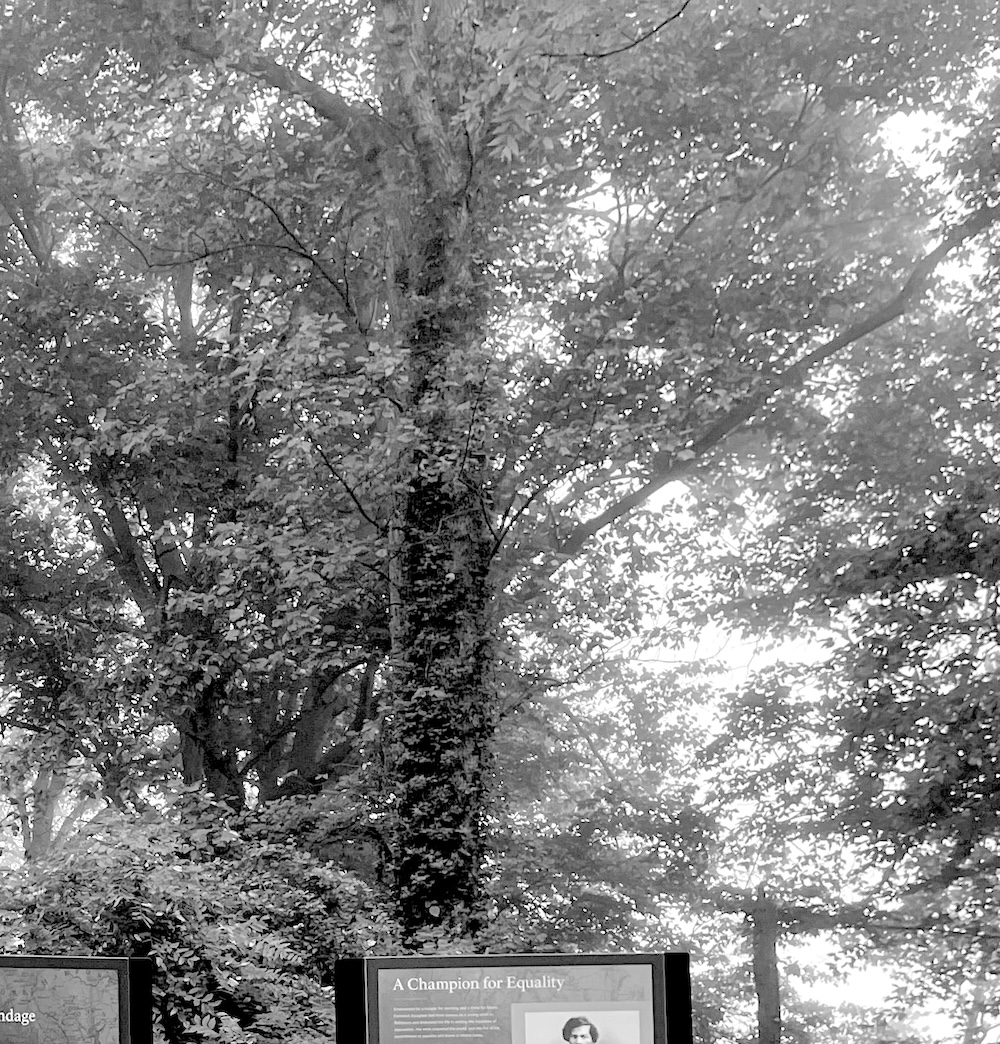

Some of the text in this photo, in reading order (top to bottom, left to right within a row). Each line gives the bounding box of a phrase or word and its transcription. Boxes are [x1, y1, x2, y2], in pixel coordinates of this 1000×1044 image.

[393, 976, 565, 993] A Champion for Equality
